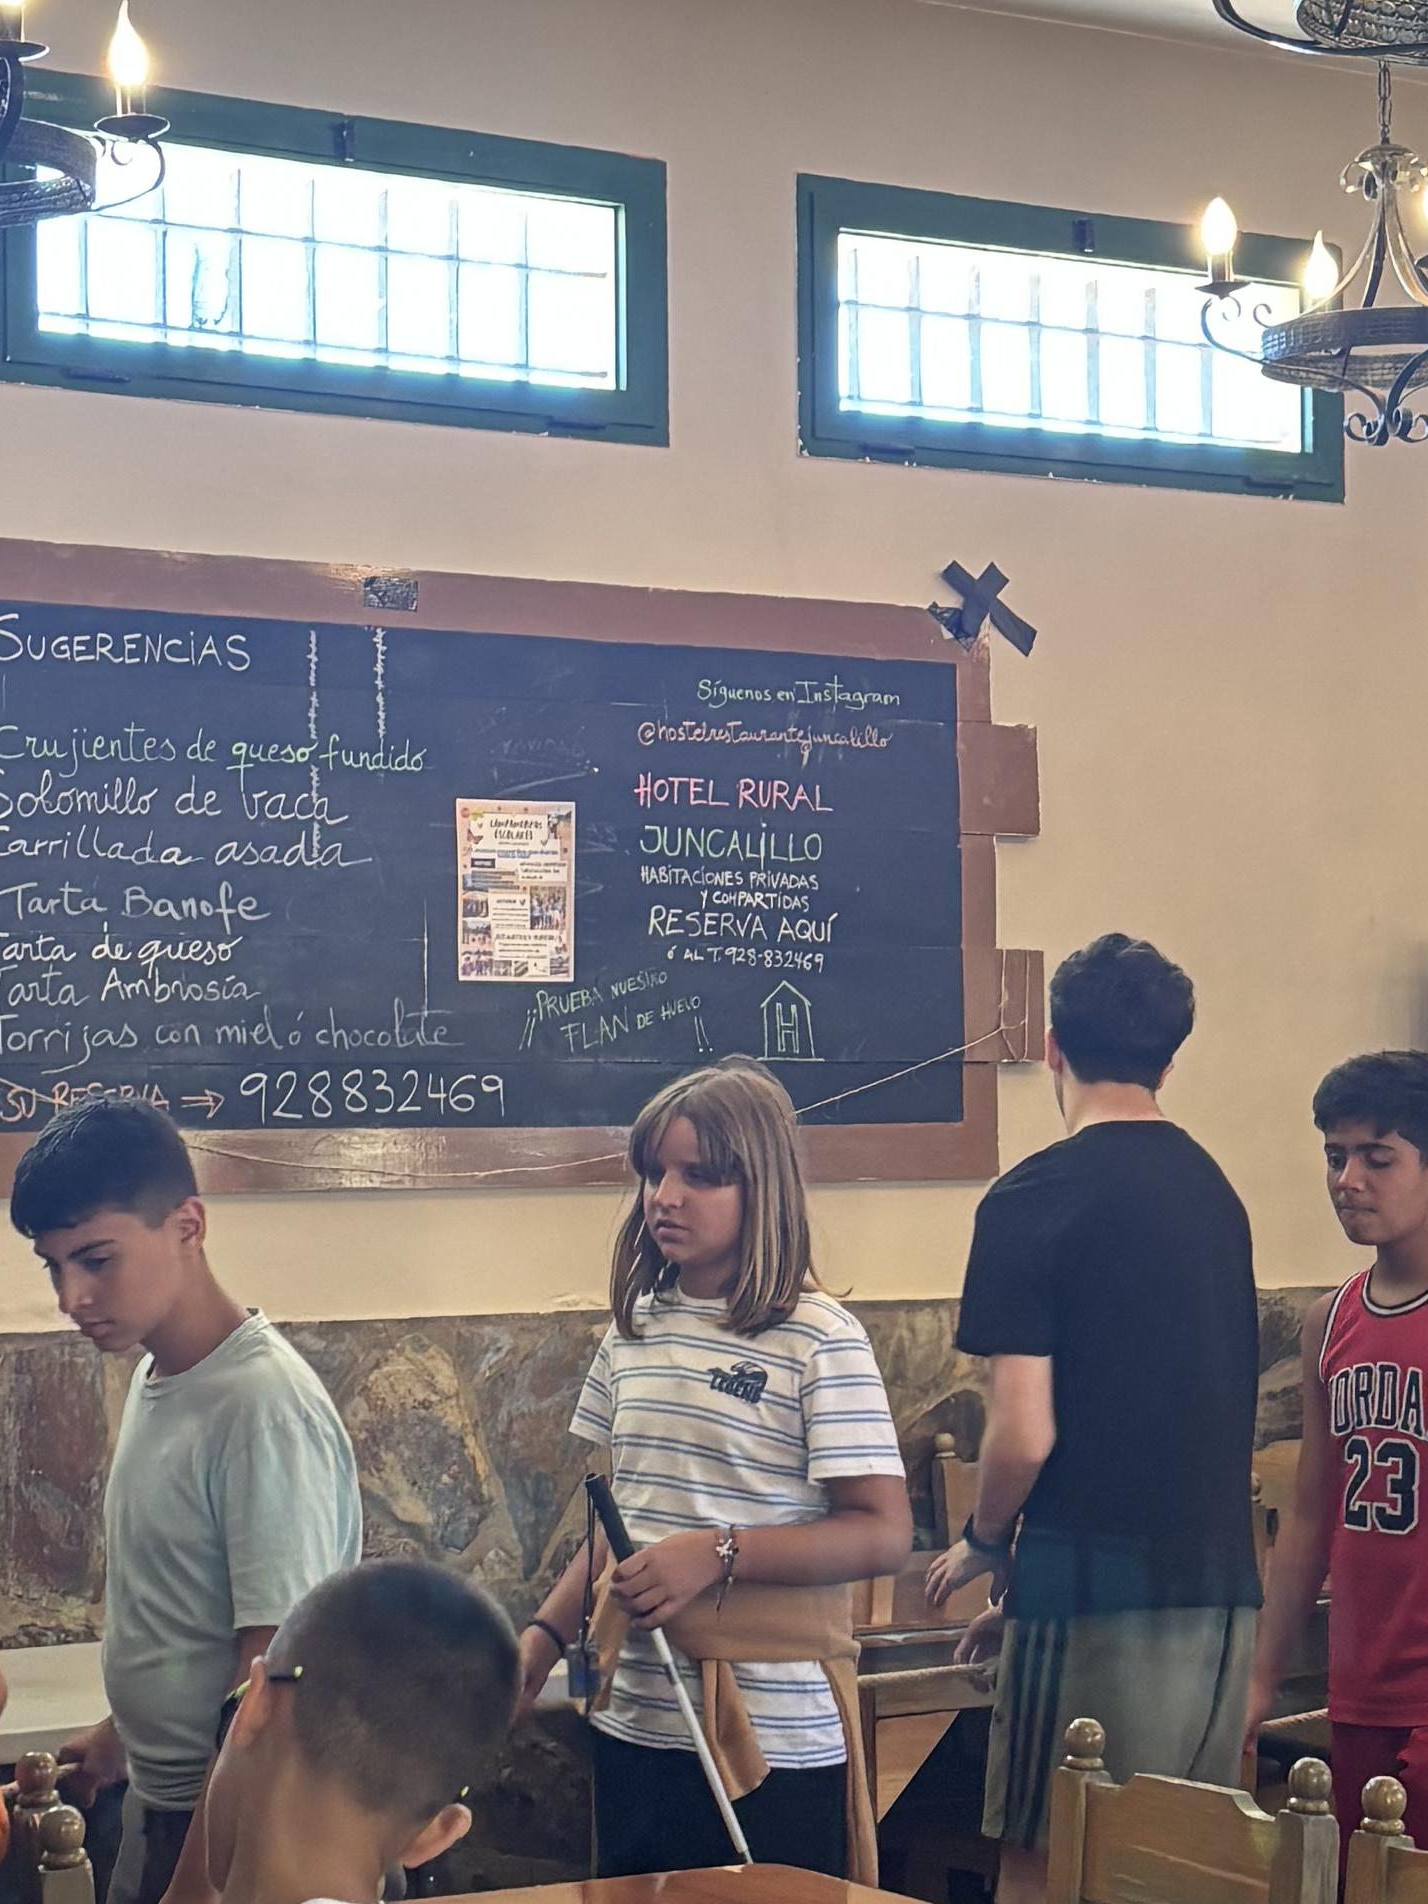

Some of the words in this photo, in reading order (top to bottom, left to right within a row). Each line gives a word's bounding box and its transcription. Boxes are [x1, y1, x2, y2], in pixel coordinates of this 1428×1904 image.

[696, 679, 772, 709] Síguenos
[777, 689, 795, 703] en
[795, 675, 901, 711] Instagram
[186, 728, 218, 763] de
[225, 739, 319, 793] queso
[319, 734, 428, 772] fundido
[175, 775, 223, 816] de
[634, 771, 730, 809] HOTEL
[737, 777, 834, 812] RURAL
[214, 824, 373, 867] asada
[749, 869, 819, 891] PRIVADAS
[121, 881, 271, 936] Banofe
[648, 904, 768, 942] RESERVA
[777, 912, 839, 943] AQUÍ
[91, 922, 132, 962] de
[138, 935, 246, 977] queso
[684, 947, 704, 961] AL
[101, 966, 262, 1005] Ambrosía
[155, 1024, 203, 1048] con
[215, 1010, 285, 1052] miel
[315, 997, 468, 1049] chocolate
[559, 1004, 630, 1053] FLAN
[636, 1010, 656, 1031] DE
[0, 1087, 37, 1123] SU
[239, 1068, 506, 1126] 928832469
[1343, 1434, 1421, 1536] 23
